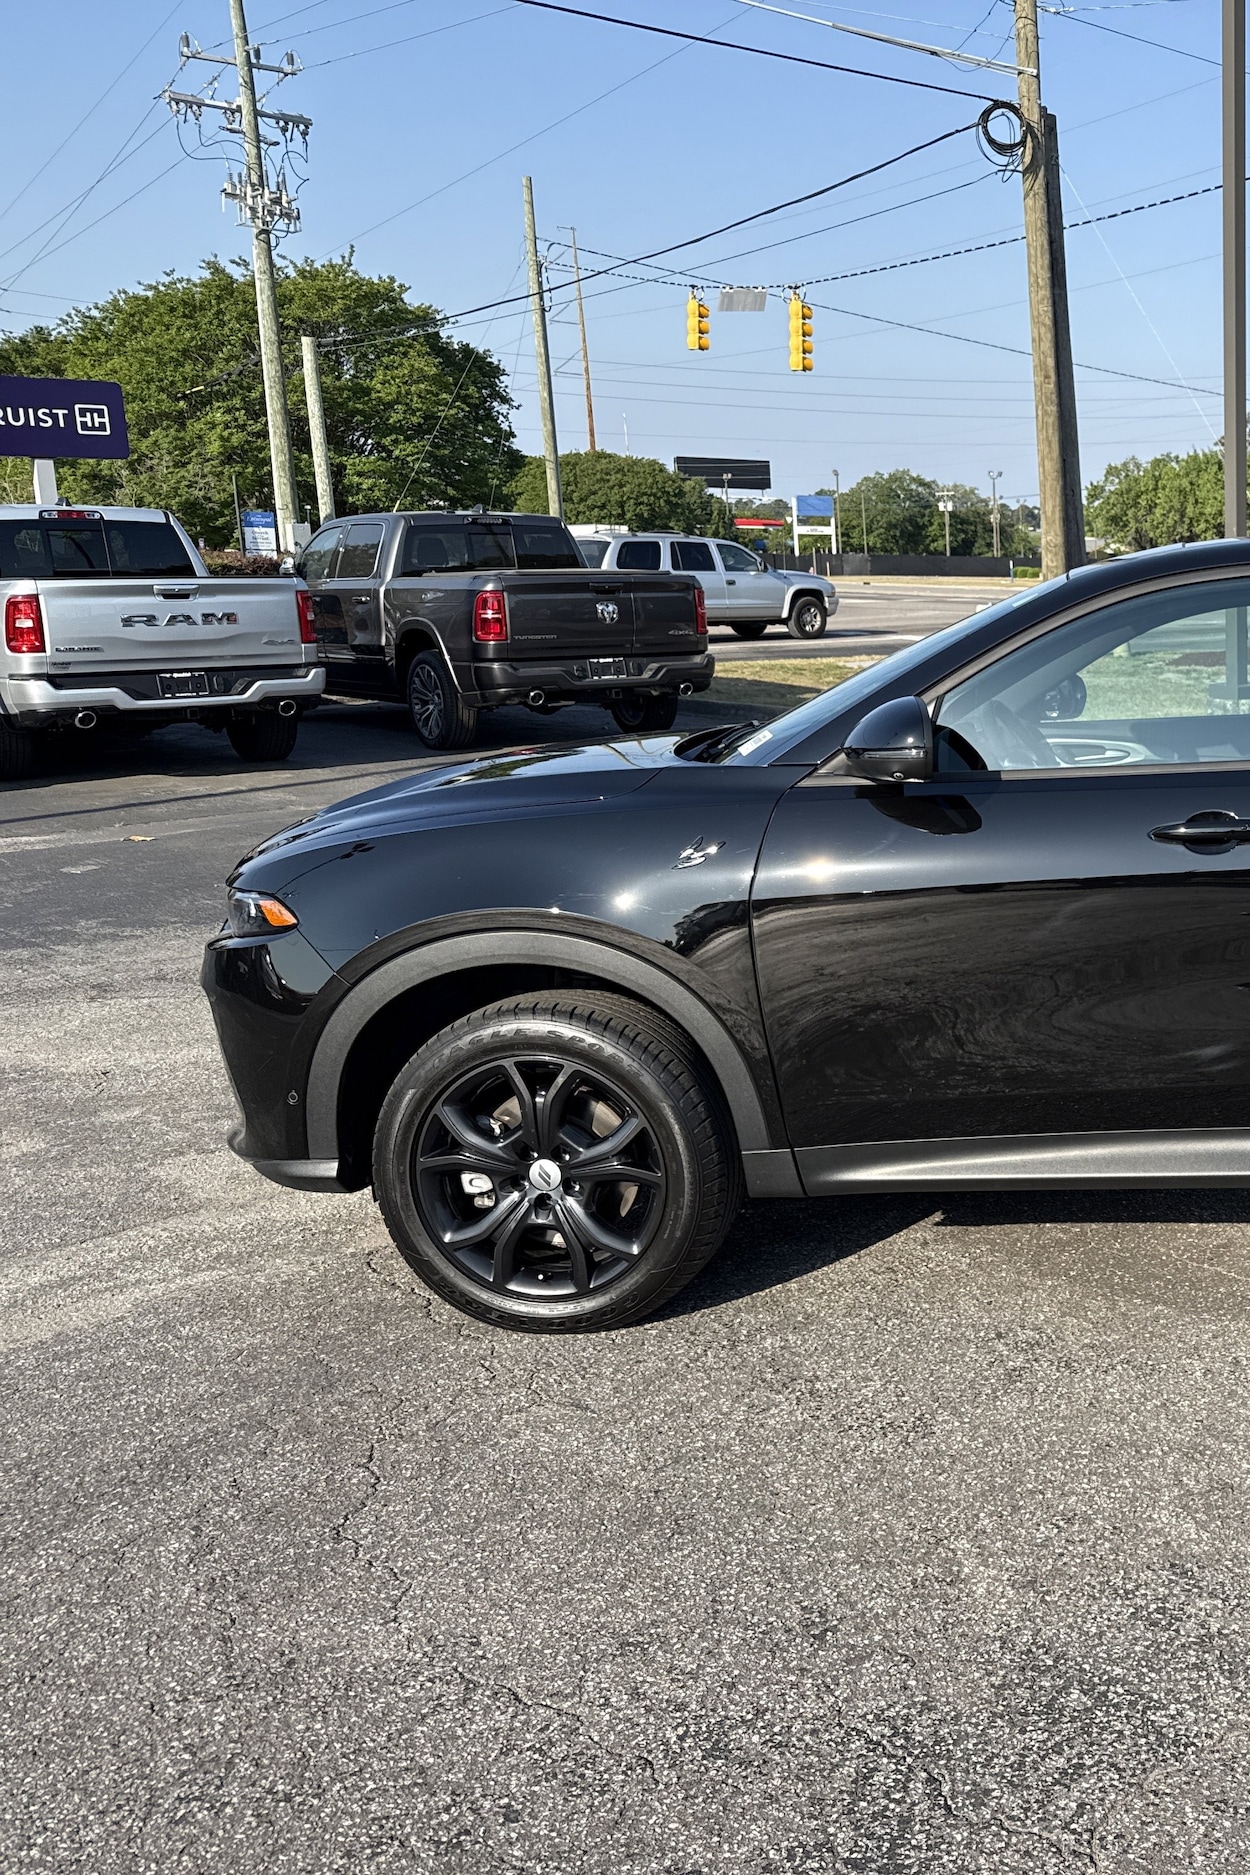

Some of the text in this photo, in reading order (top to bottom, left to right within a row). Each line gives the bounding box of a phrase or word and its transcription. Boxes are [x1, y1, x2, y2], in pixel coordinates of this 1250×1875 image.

[120, 612, 239, 627] RAM
[432, 1027, 646, 1079] EAGLE SPORT
